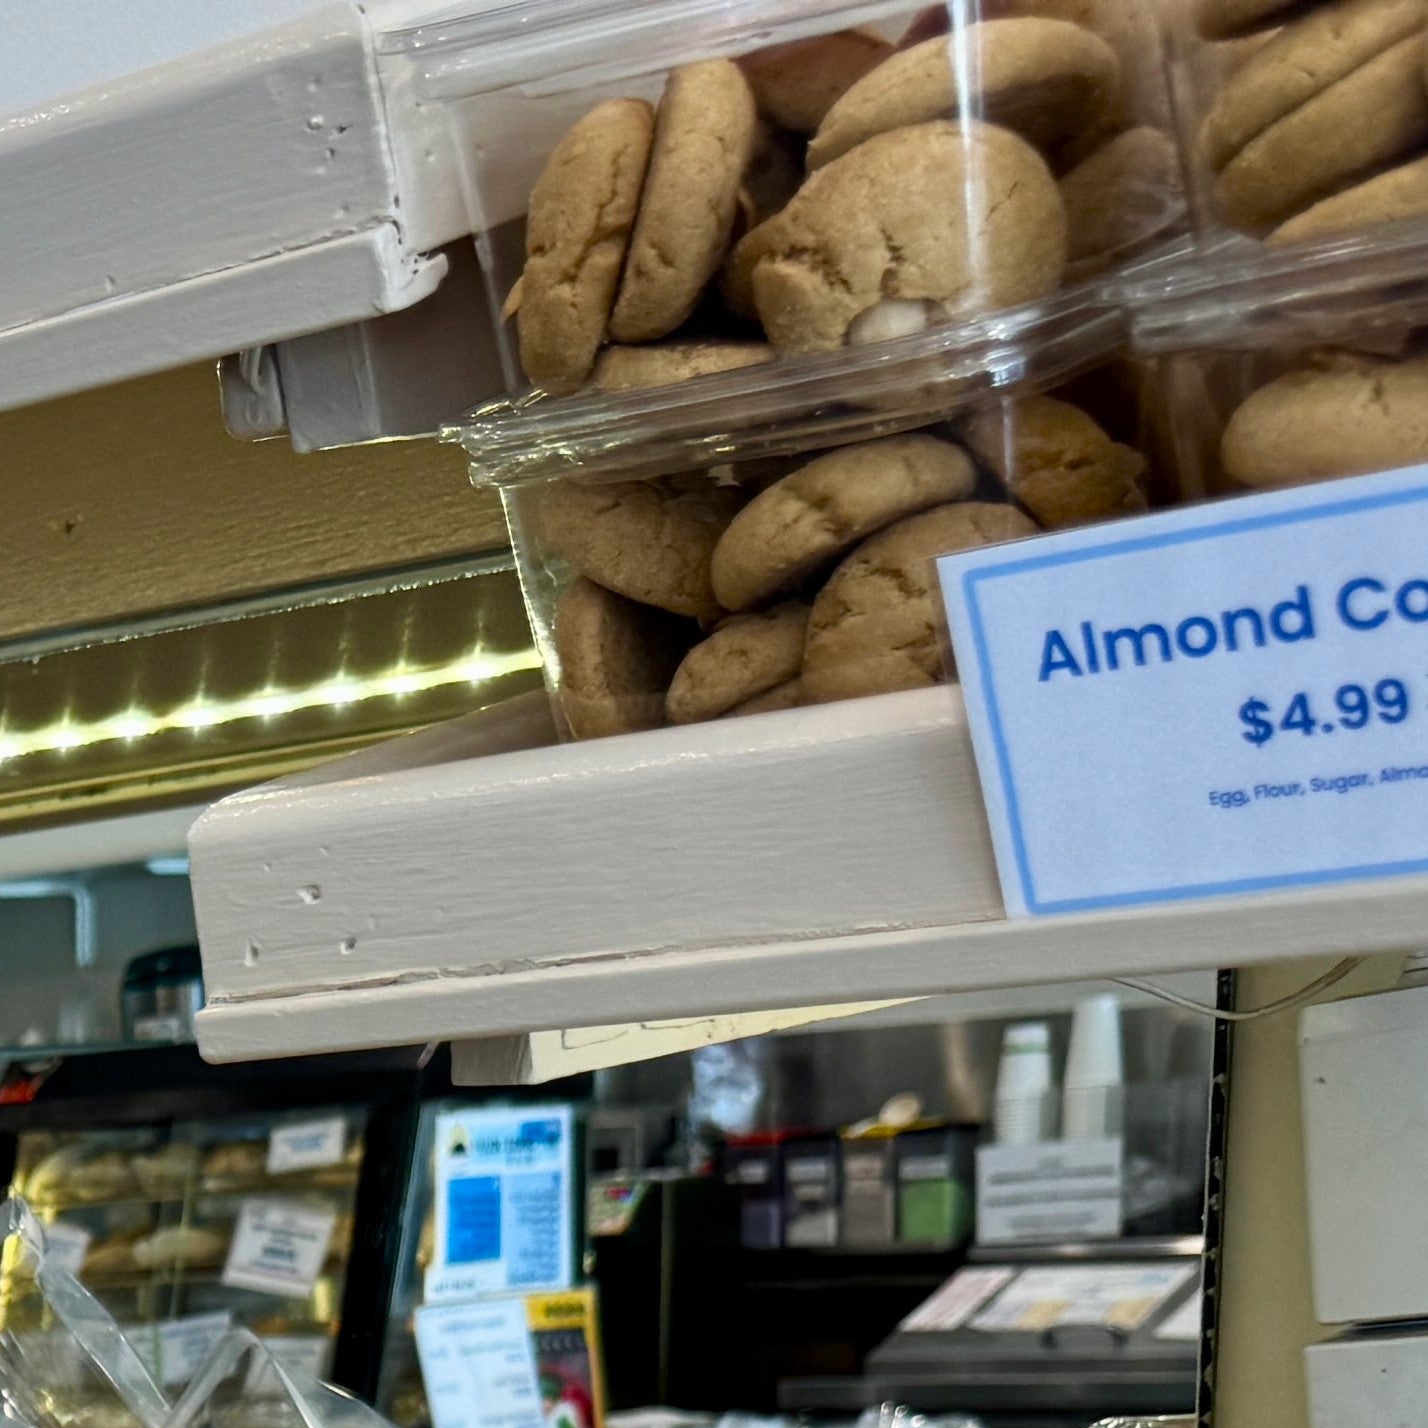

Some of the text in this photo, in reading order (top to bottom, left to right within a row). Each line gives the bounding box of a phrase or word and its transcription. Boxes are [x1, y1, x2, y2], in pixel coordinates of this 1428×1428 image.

[1039, 585, 1315, 682] Almond
[1238, 678, 1410, 748] $4.99
[1209, 788, 1250, 809] Egg,
[1253, 783, 1307, 802] Flour,
[1310, 772, 1374, 797] Sugar,
